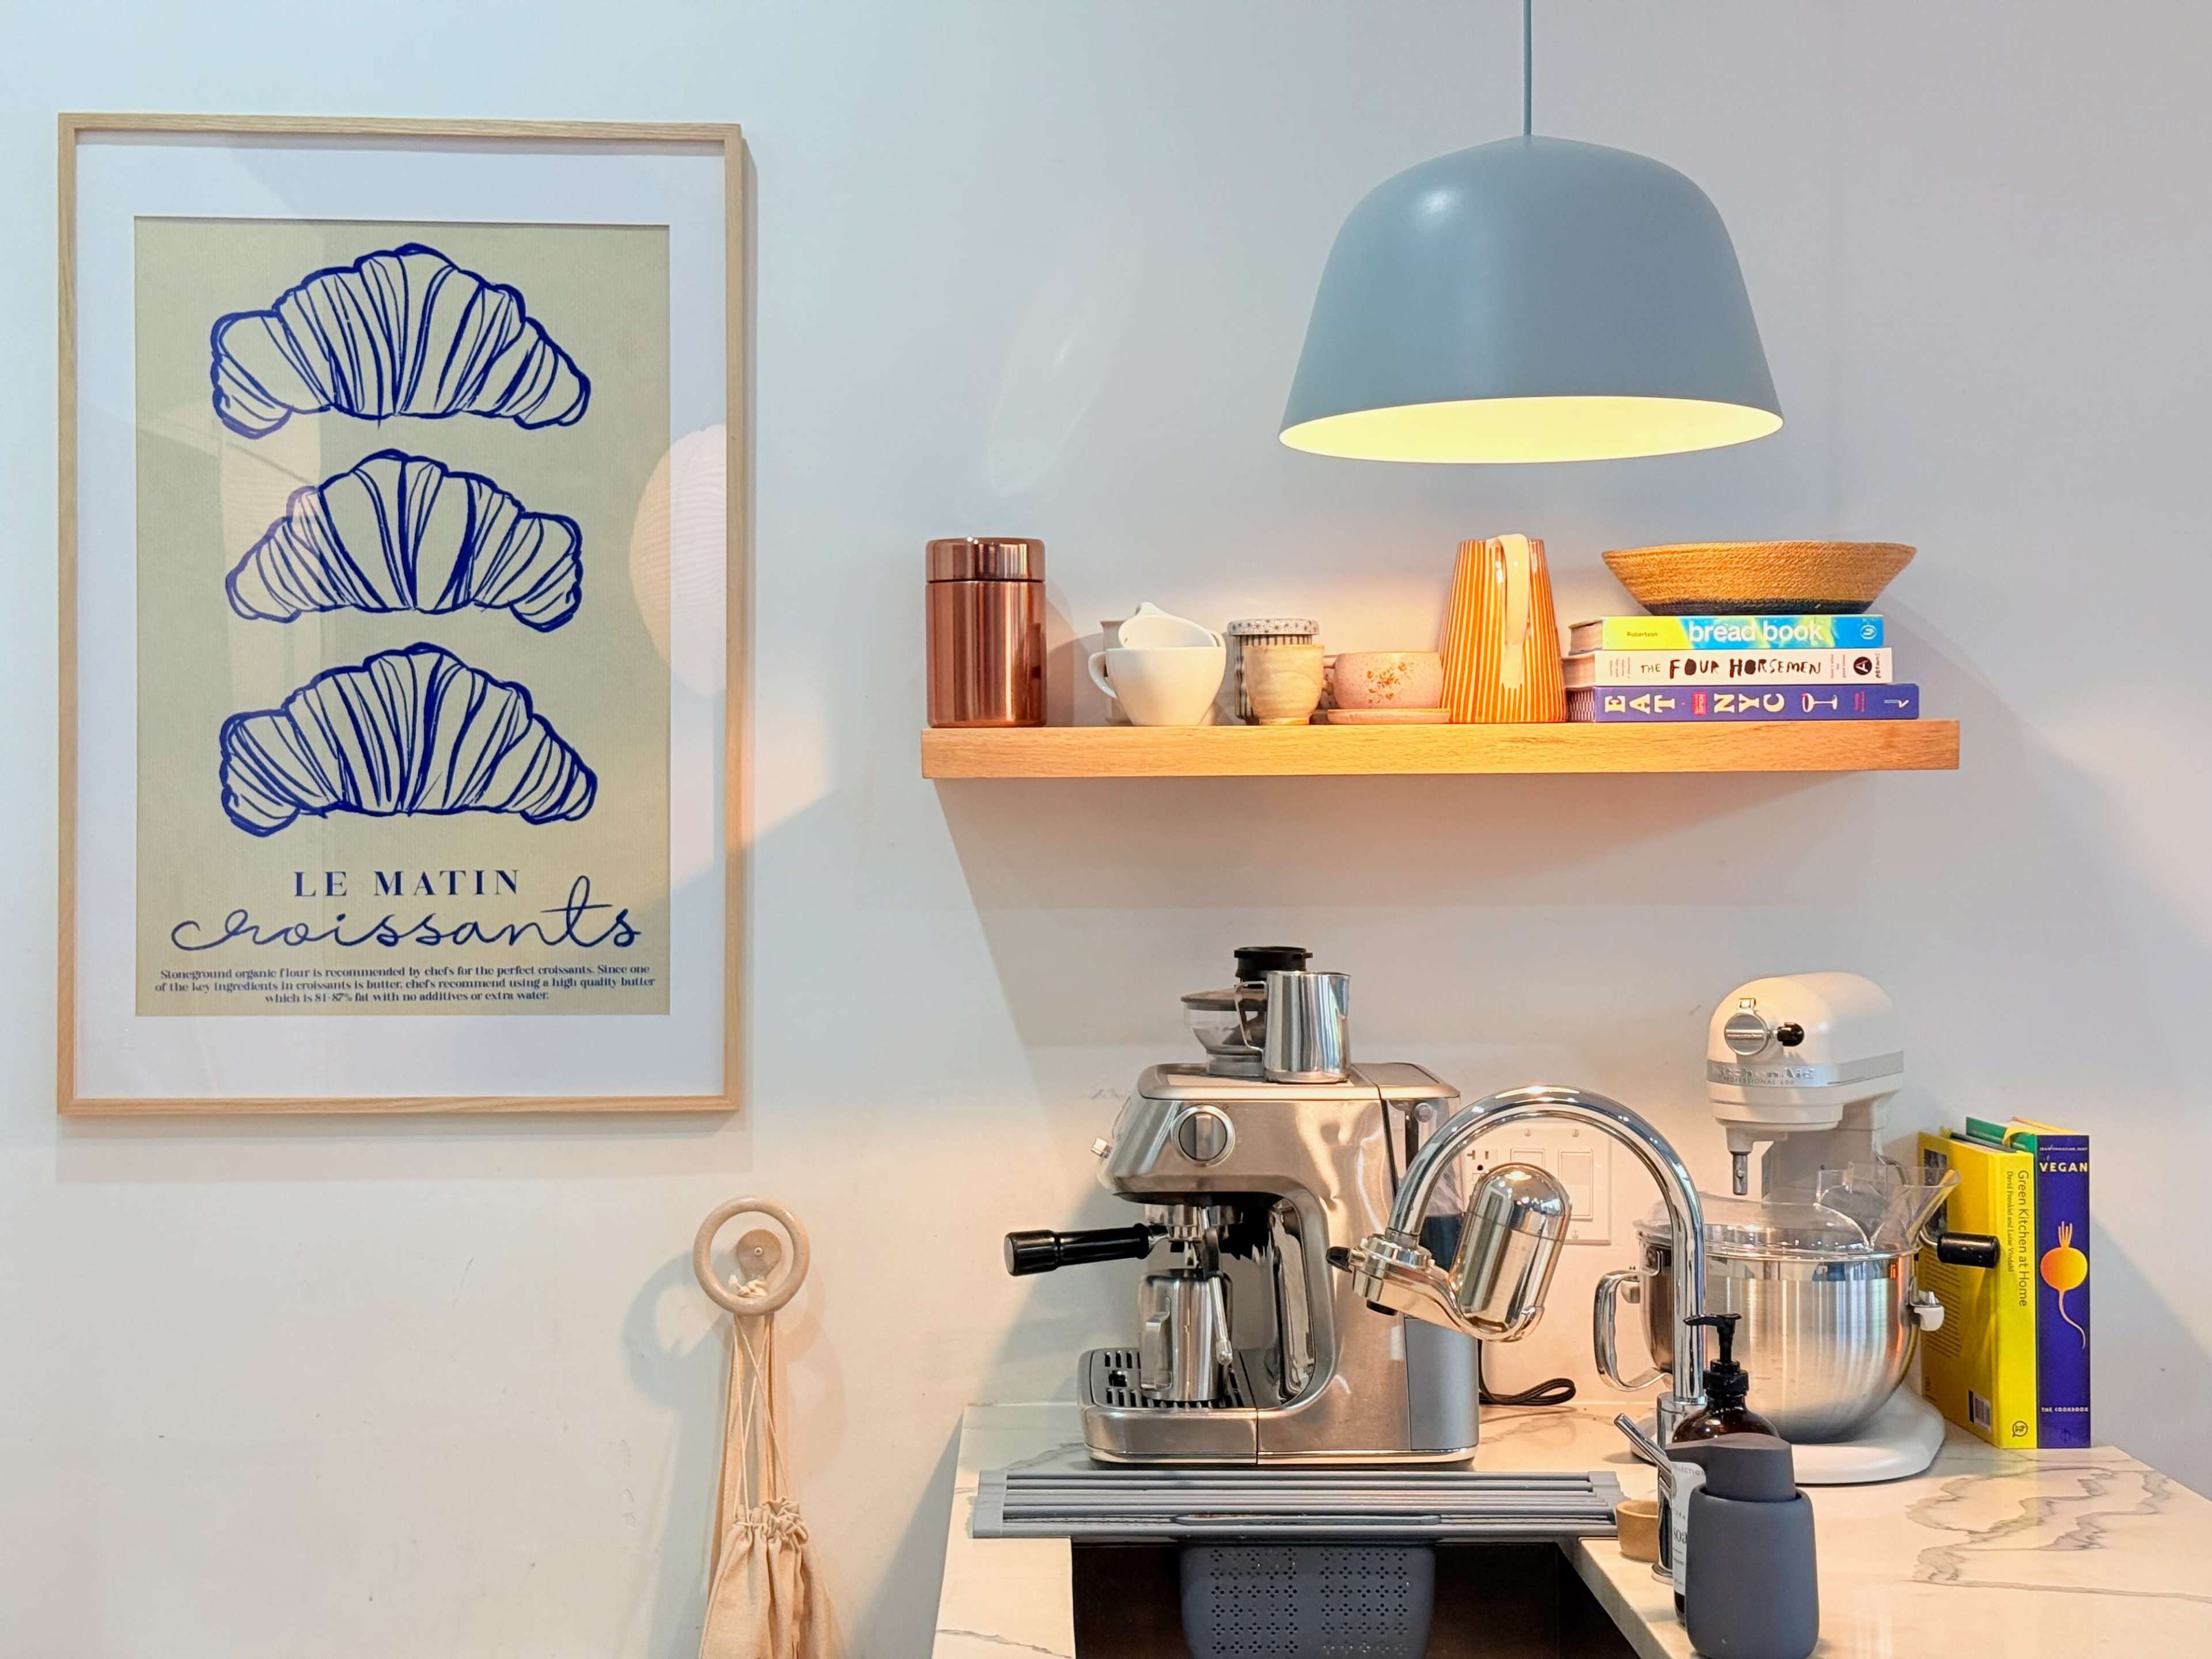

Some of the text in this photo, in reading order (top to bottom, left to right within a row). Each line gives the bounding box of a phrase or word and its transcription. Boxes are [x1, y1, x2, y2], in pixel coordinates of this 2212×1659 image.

[1689, 620, 1824, 642] bread book
[1641, 664, 1661, 674] THE
[1670, 658, 1719, 679] FOUR
[1729, 658, 1821, 678] HORSEMEN
[1605, 694, 1675, 714] EAT
[1714, 693, 1785, 713] NYC
[294, 870, 519, 897] LE MATIN
[161, 969, 232, 980] Stoneground
[235, 969, 276, 980] organic
[313, 968, 322, 977] is
[325, 967, 405, 977] recommended
[410, 967, 421, 978] by
[424, 966, 454, 976] chefs
[457, 966, 473, 975] for
[476, 965, 494, 975] the
[497, 965, 535, 977] perfect
[597, 964, 627, 974] Since
[630, 965, 650, 974] one
[155, 983, 167, 992] of
[169, 982, 189, 991] the
[192, 982, 210, 993] key
[214, 981, 278, 993] ingredients
[281, 981, 293, 990] in
[296, 980, 351, 990] croissants
[355, 980, 363, 989] is
[406, 979, 435, 988] chefs
[438, 978, 506, 988] recommend
[509, 978, 540, 989] using
[552, 978, 578, 988] high
[580, 977, 616, 988] quality
[621, 977, 655, 986] butter
[266, 994, 300, 1003] which
[304, 994, 313, 1002] is
[355, 992, 369, 1002] fat
[373, 992, 399, 1001] with
[419, 991, 468, 1001] additives
[485, 992, 513, 1000] extra
[2039, 1162, 2088, 1172] VEGAN
[2018, 1170, 2030, 1307] Green Kitchen at Home
